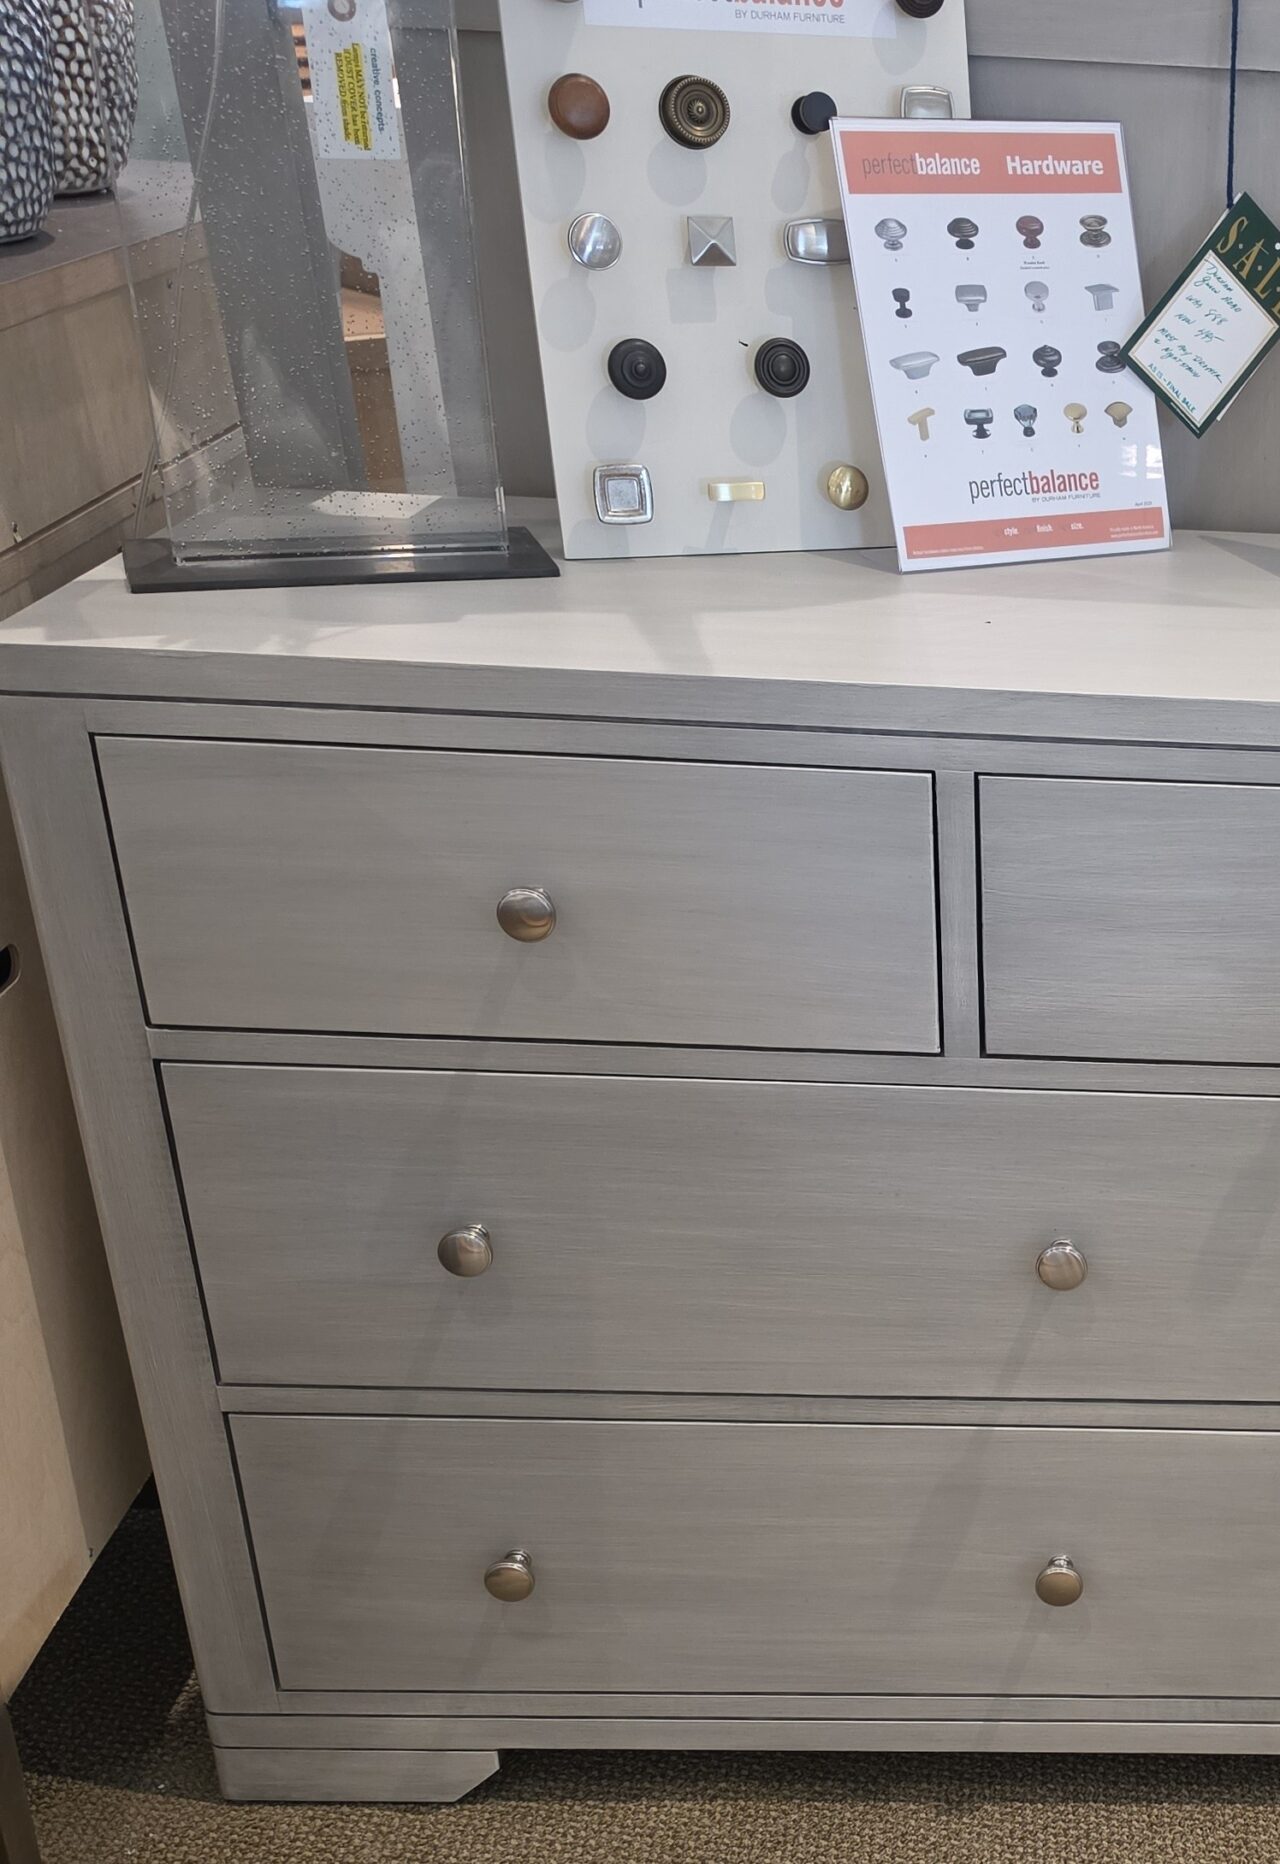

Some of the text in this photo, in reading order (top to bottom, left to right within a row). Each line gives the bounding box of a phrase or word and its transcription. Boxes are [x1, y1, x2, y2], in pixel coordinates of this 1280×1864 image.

[734, 8, 845, 24] BY DURHAM FURNITURE
[862, 153, 1104, 178] perfectbalance Hardware
[1166, 381, 1180, 399] FINAL
[969, 469, 1099, 504] perfectbalance
